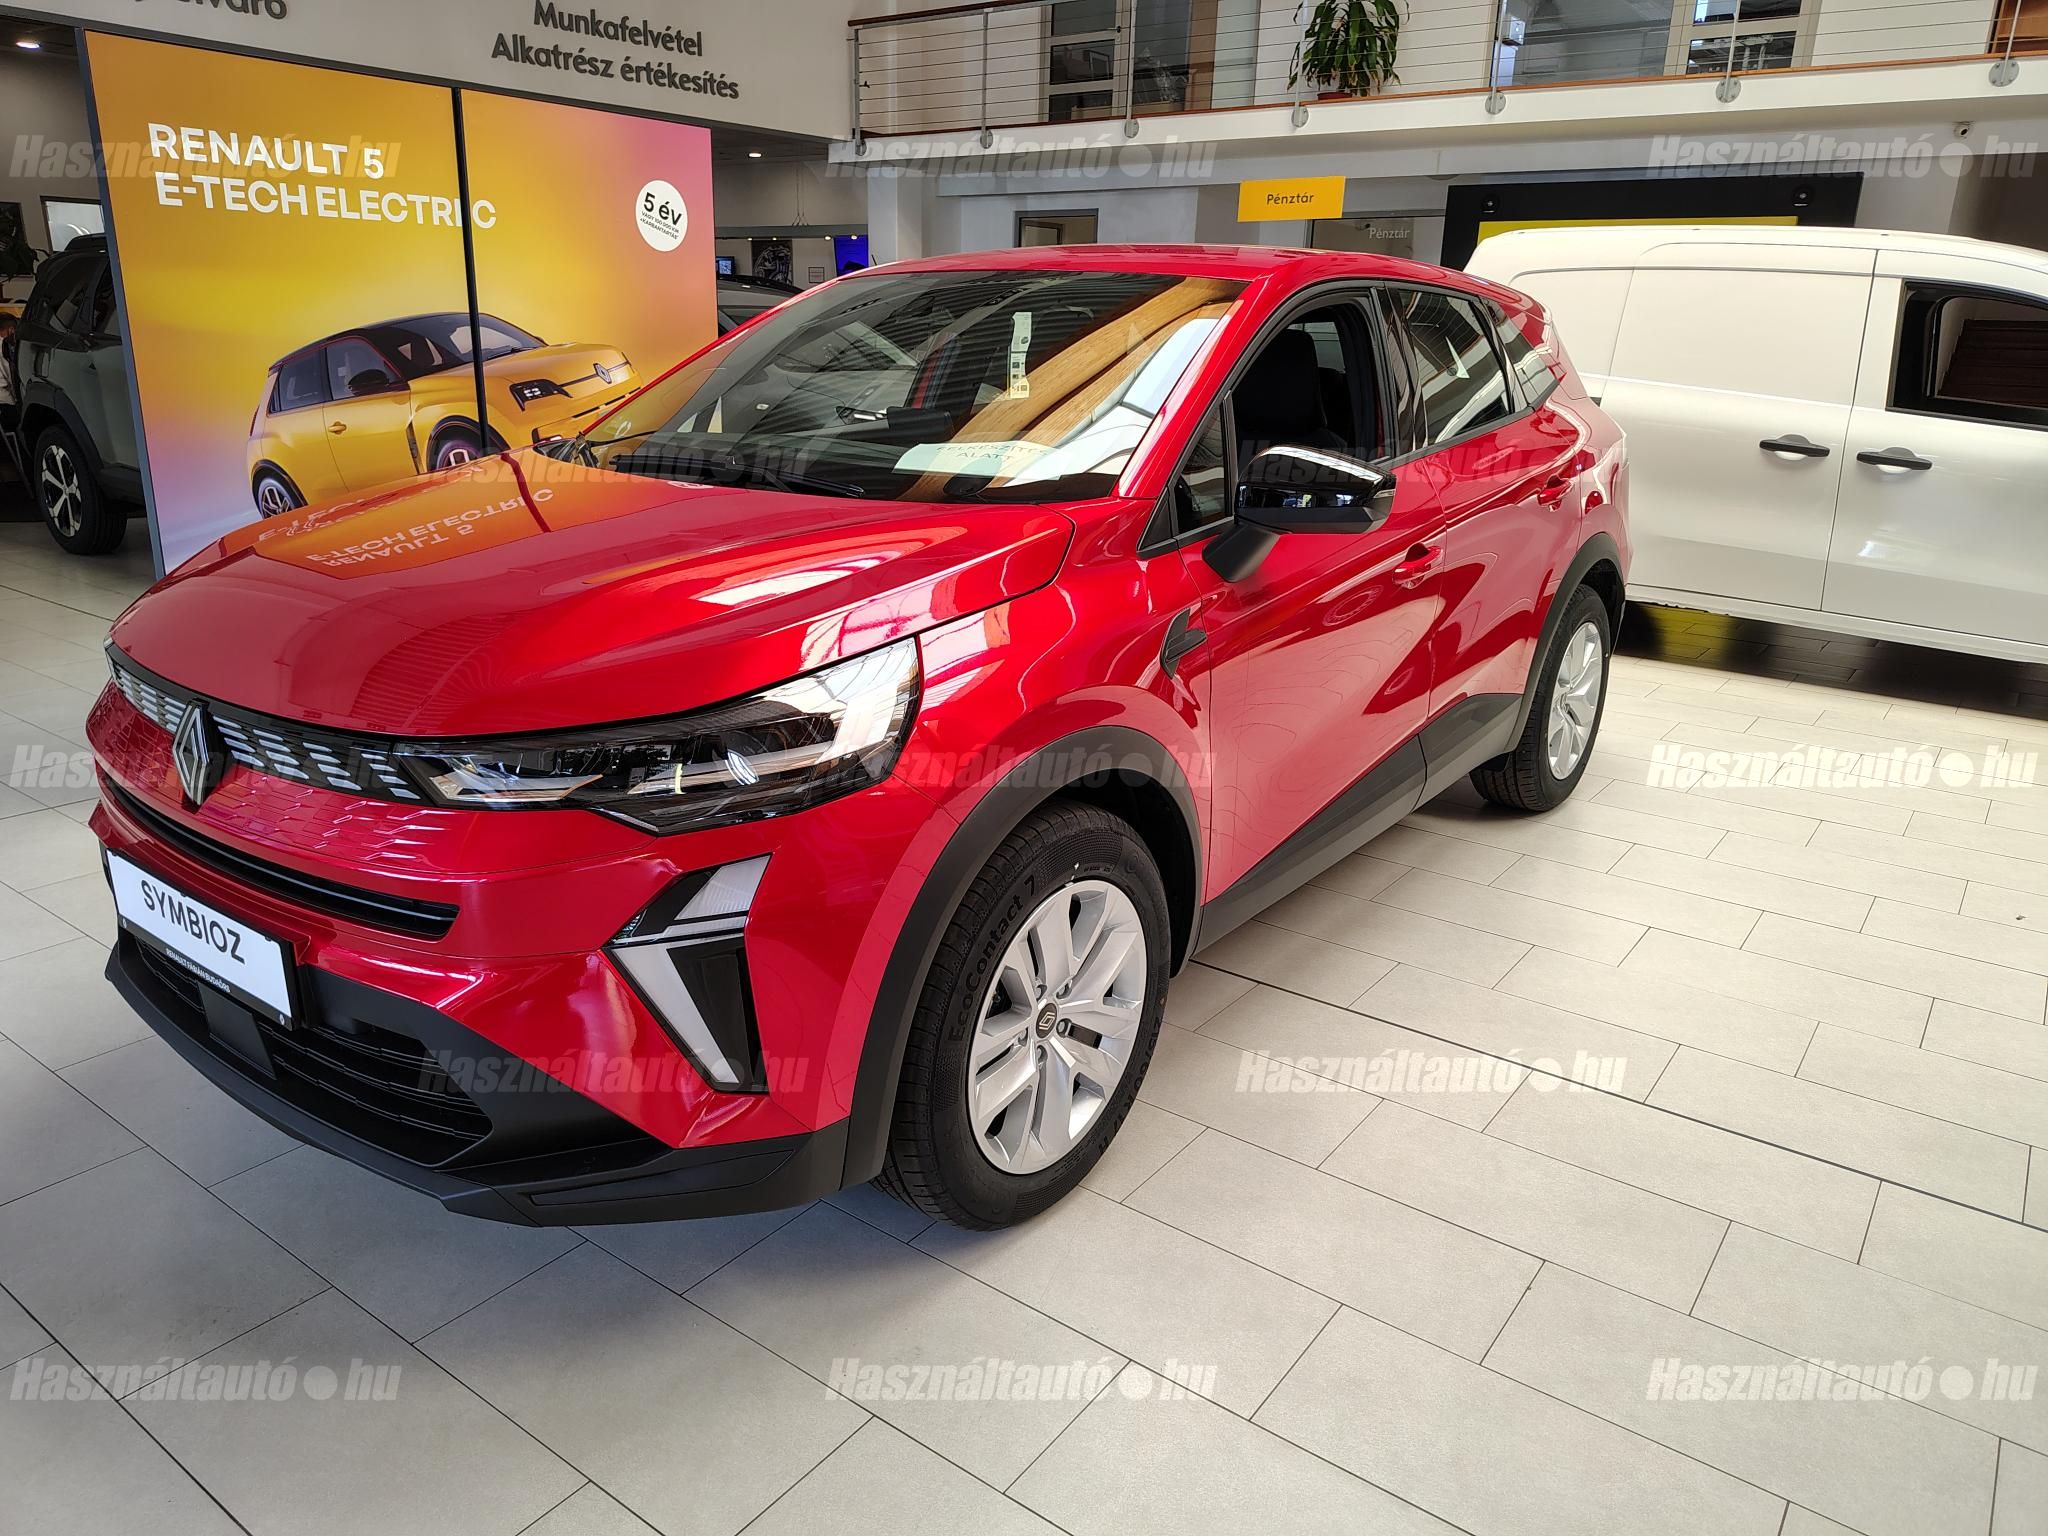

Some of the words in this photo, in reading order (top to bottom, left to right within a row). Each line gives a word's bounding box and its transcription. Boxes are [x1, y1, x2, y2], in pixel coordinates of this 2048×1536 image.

[533, 0, 703, 57] Munkafelvétel
[491, 32, 614, 79] Alkatrész
[619, 55, 740, 99] értékesítés
[148, 122, 347, 175] RENAULT
[363, 147, 384, 179] 5
[155, 171, 308, 216] E-TECH
[316, 184, 497, 229] ELECTRIC
[643, 192, 655, 212] 5
[658, 201, 682, 225] év
[1266, 193, 1315, 205] Pénztár
[1368, 227, 1411, 239] Pénztár
[140, 879, 246, 965] SYMBIOZ
[949, 893, 1025, 1041] EcoContact
[1024, 874, 1036, 897] 7
